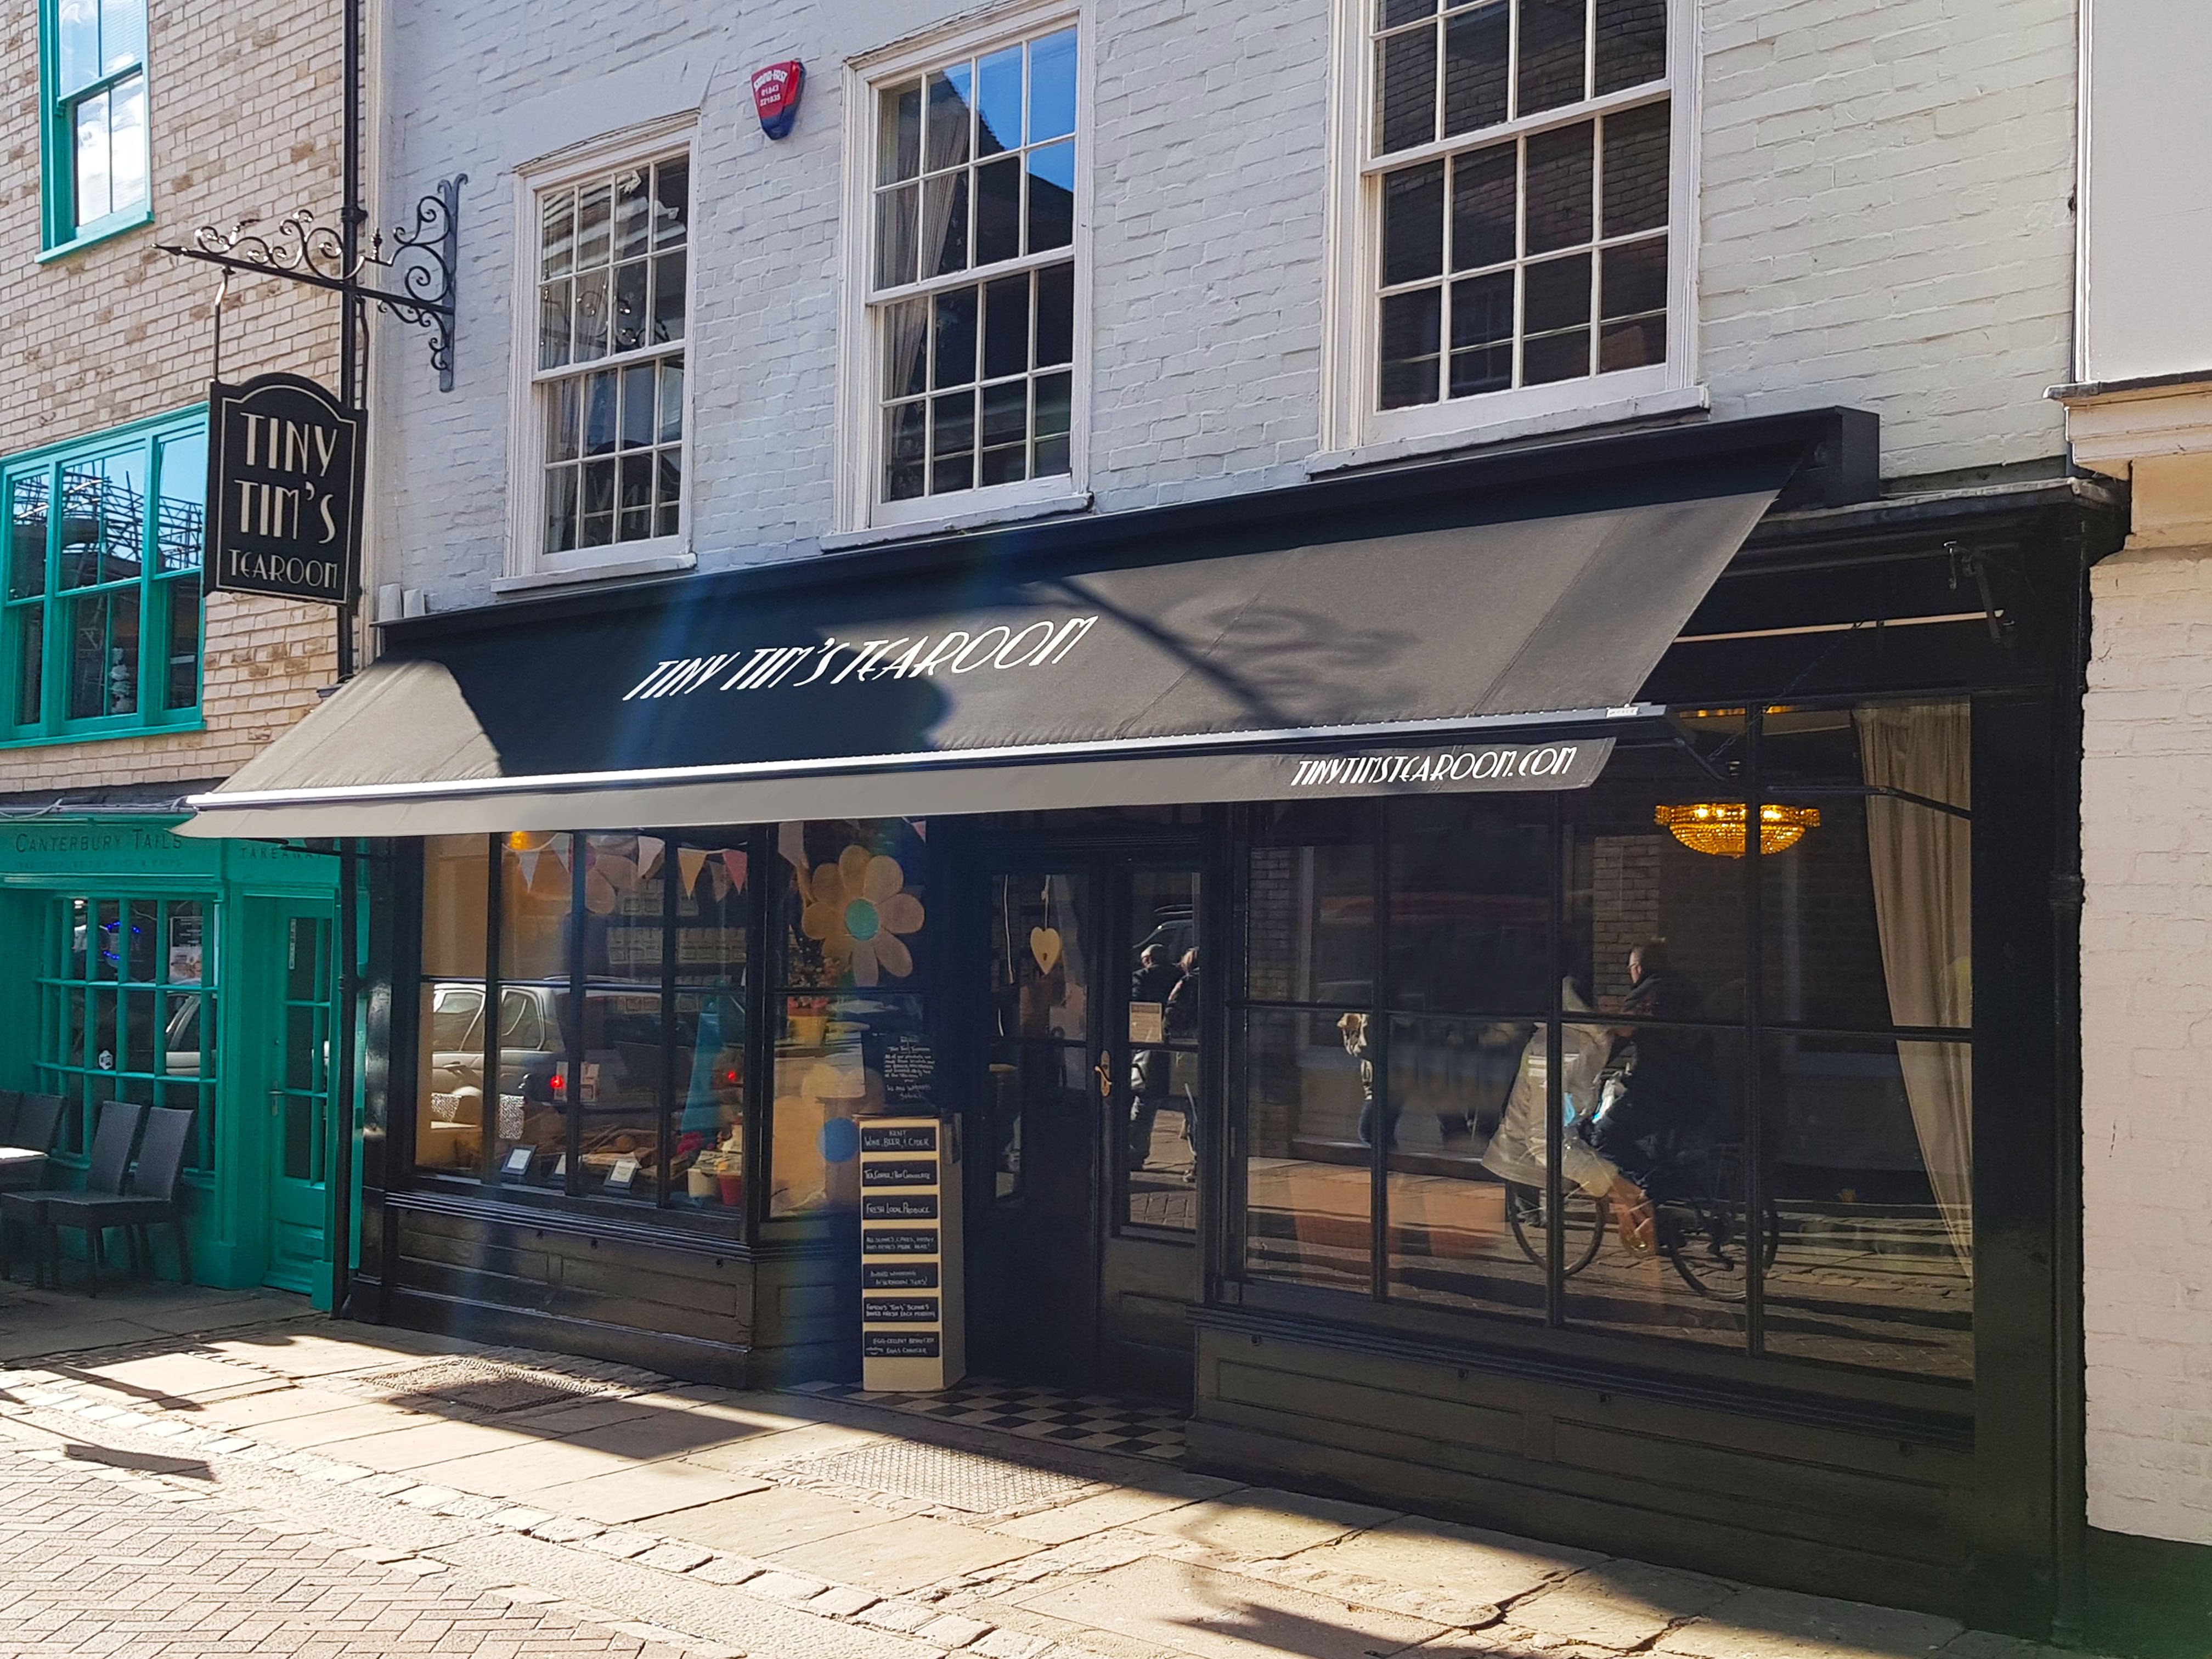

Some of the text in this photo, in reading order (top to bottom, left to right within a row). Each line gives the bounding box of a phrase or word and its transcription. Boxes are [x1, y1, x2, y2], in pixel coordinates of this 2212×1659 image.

[240, 412, 337, 477] TINY
[234, 479, 336, 544] TIM'S
[229, 549, 337, 589] TEAROOM
[623, 615, 1098, 701] TINY TIM'S TEAROOM
[1291, 746, 1578, 786] TINYTIMSTEAROOM.COM
[16, 828, 182, 853] CANTERBURY TAILS
